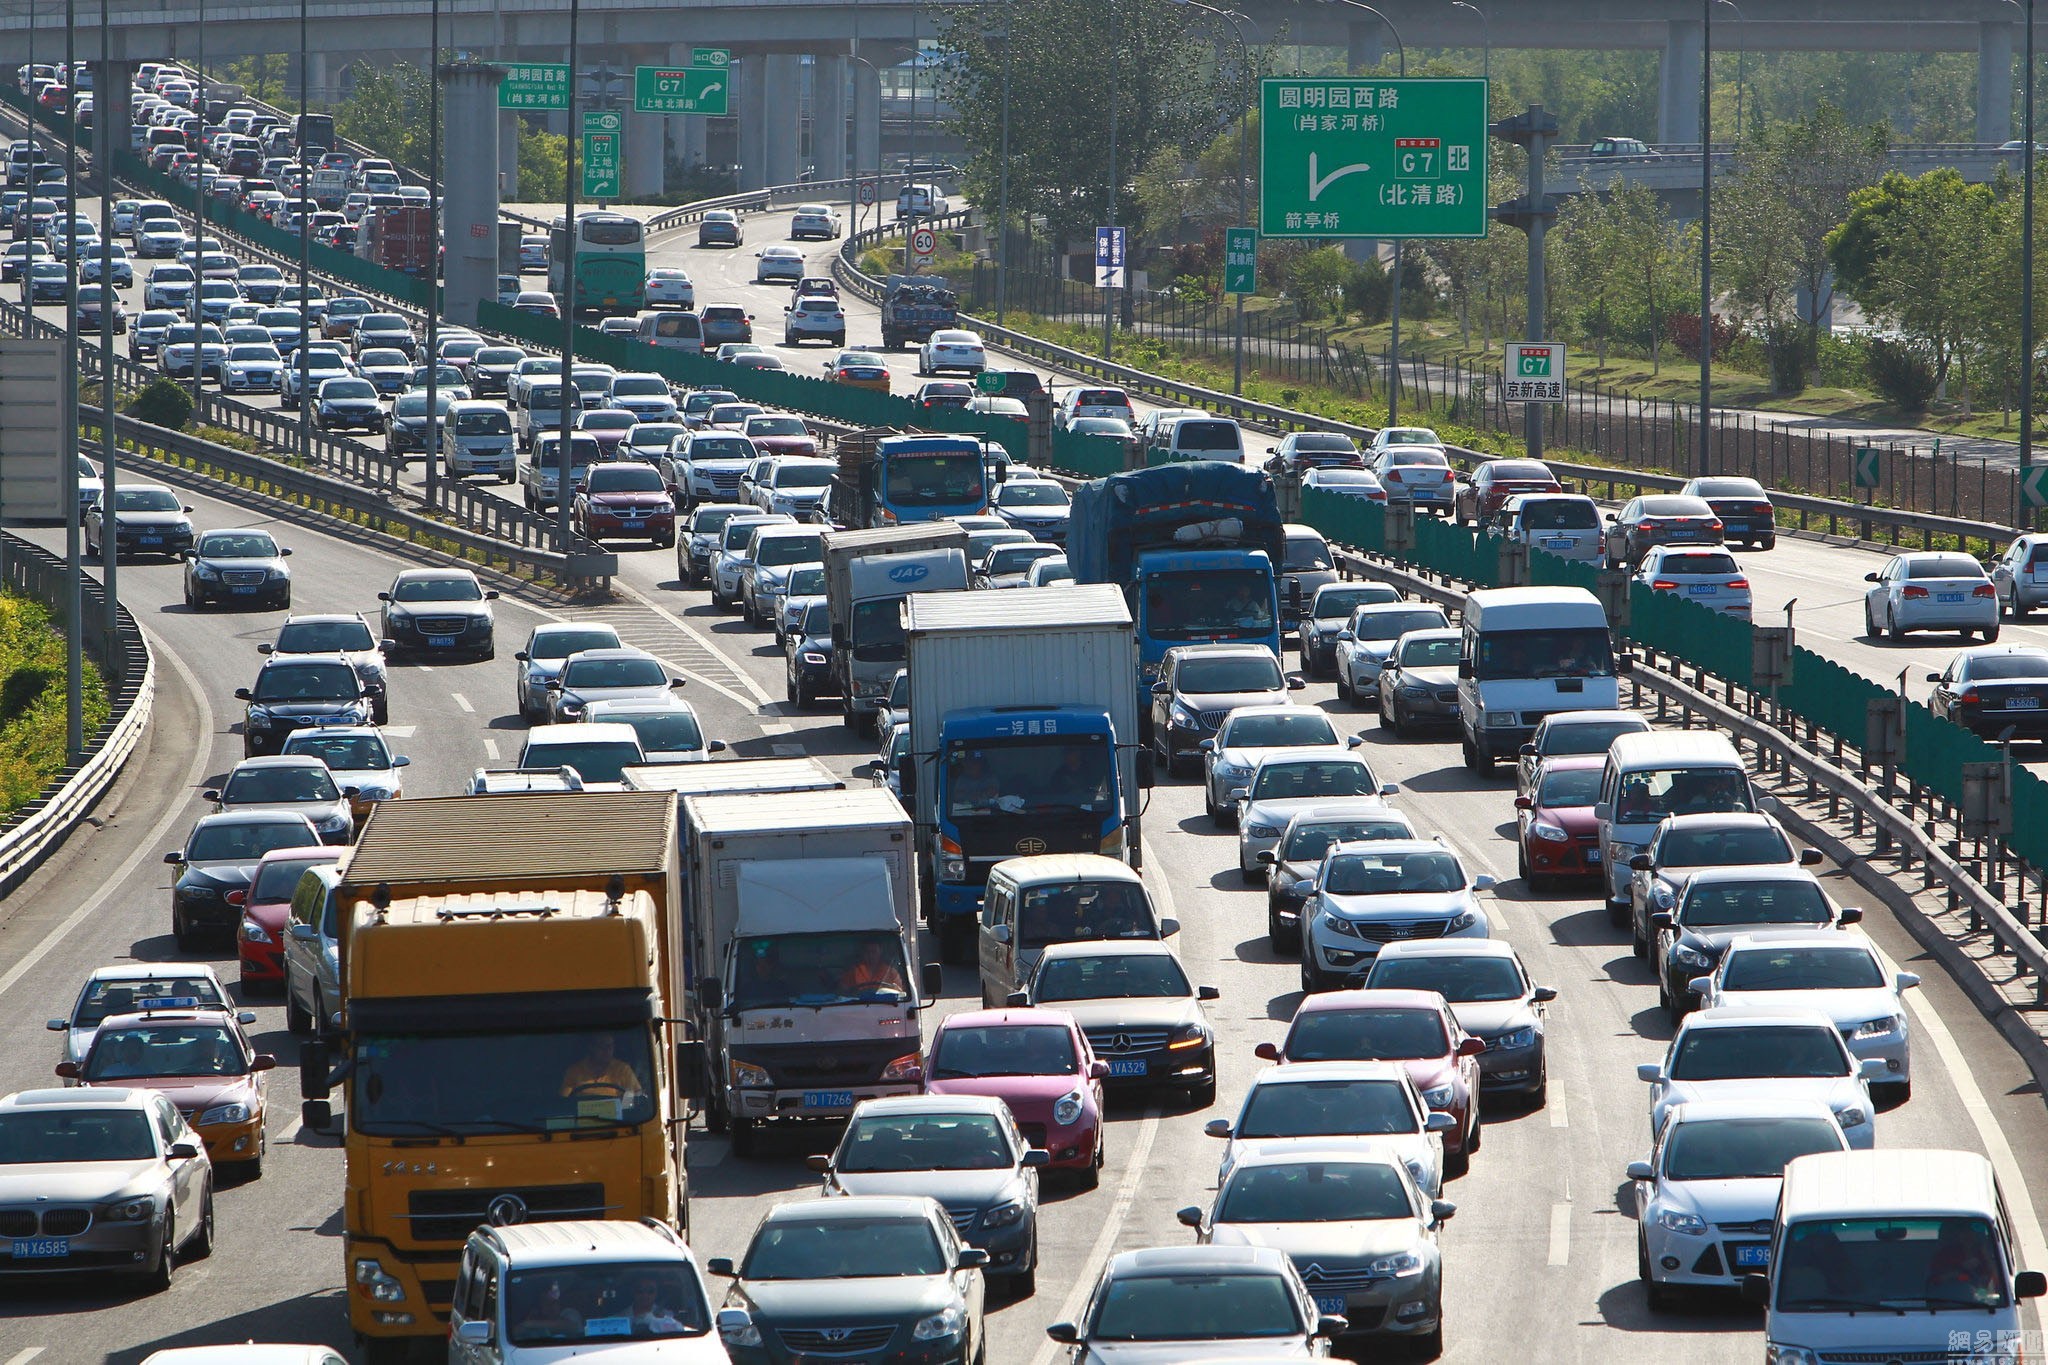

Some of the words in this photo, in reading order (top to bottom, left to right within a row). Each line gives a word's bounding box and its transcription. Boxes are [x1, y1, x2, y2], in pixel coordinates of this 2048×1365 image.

[507, 68, 566, 82] 圆明园西路
[660, 79, 680, 92] G7
[1279, 87, 1400, 109] 圆明园西路
[1293, 114, 1385, 132] (肖家河桥)
[594, 142, 609, 153] G7
[589, 157, 613, 167] 上地
[1402, 153, 1433, 173] G7
[1450, 148, 1467, 169] 北
[587, 168, 615, 179] 北清路
[1379, 184, 1464, 206] (北清路)
[1285, 212, 1340, 229] 箭亭桥
[916, 235, 932, 248] 60
[1099, 237, 1109, 257] 保利
[1233, 237, 1251, 250] 华润
[1523, 358, 1547, 374] G7
[985, 376, 998, 385] 88
[1506, 381, 1561, 399] 京新高速
[890, 566, 927, 579] JAC
[995, 719, 1057, 735] 一汽青岛
